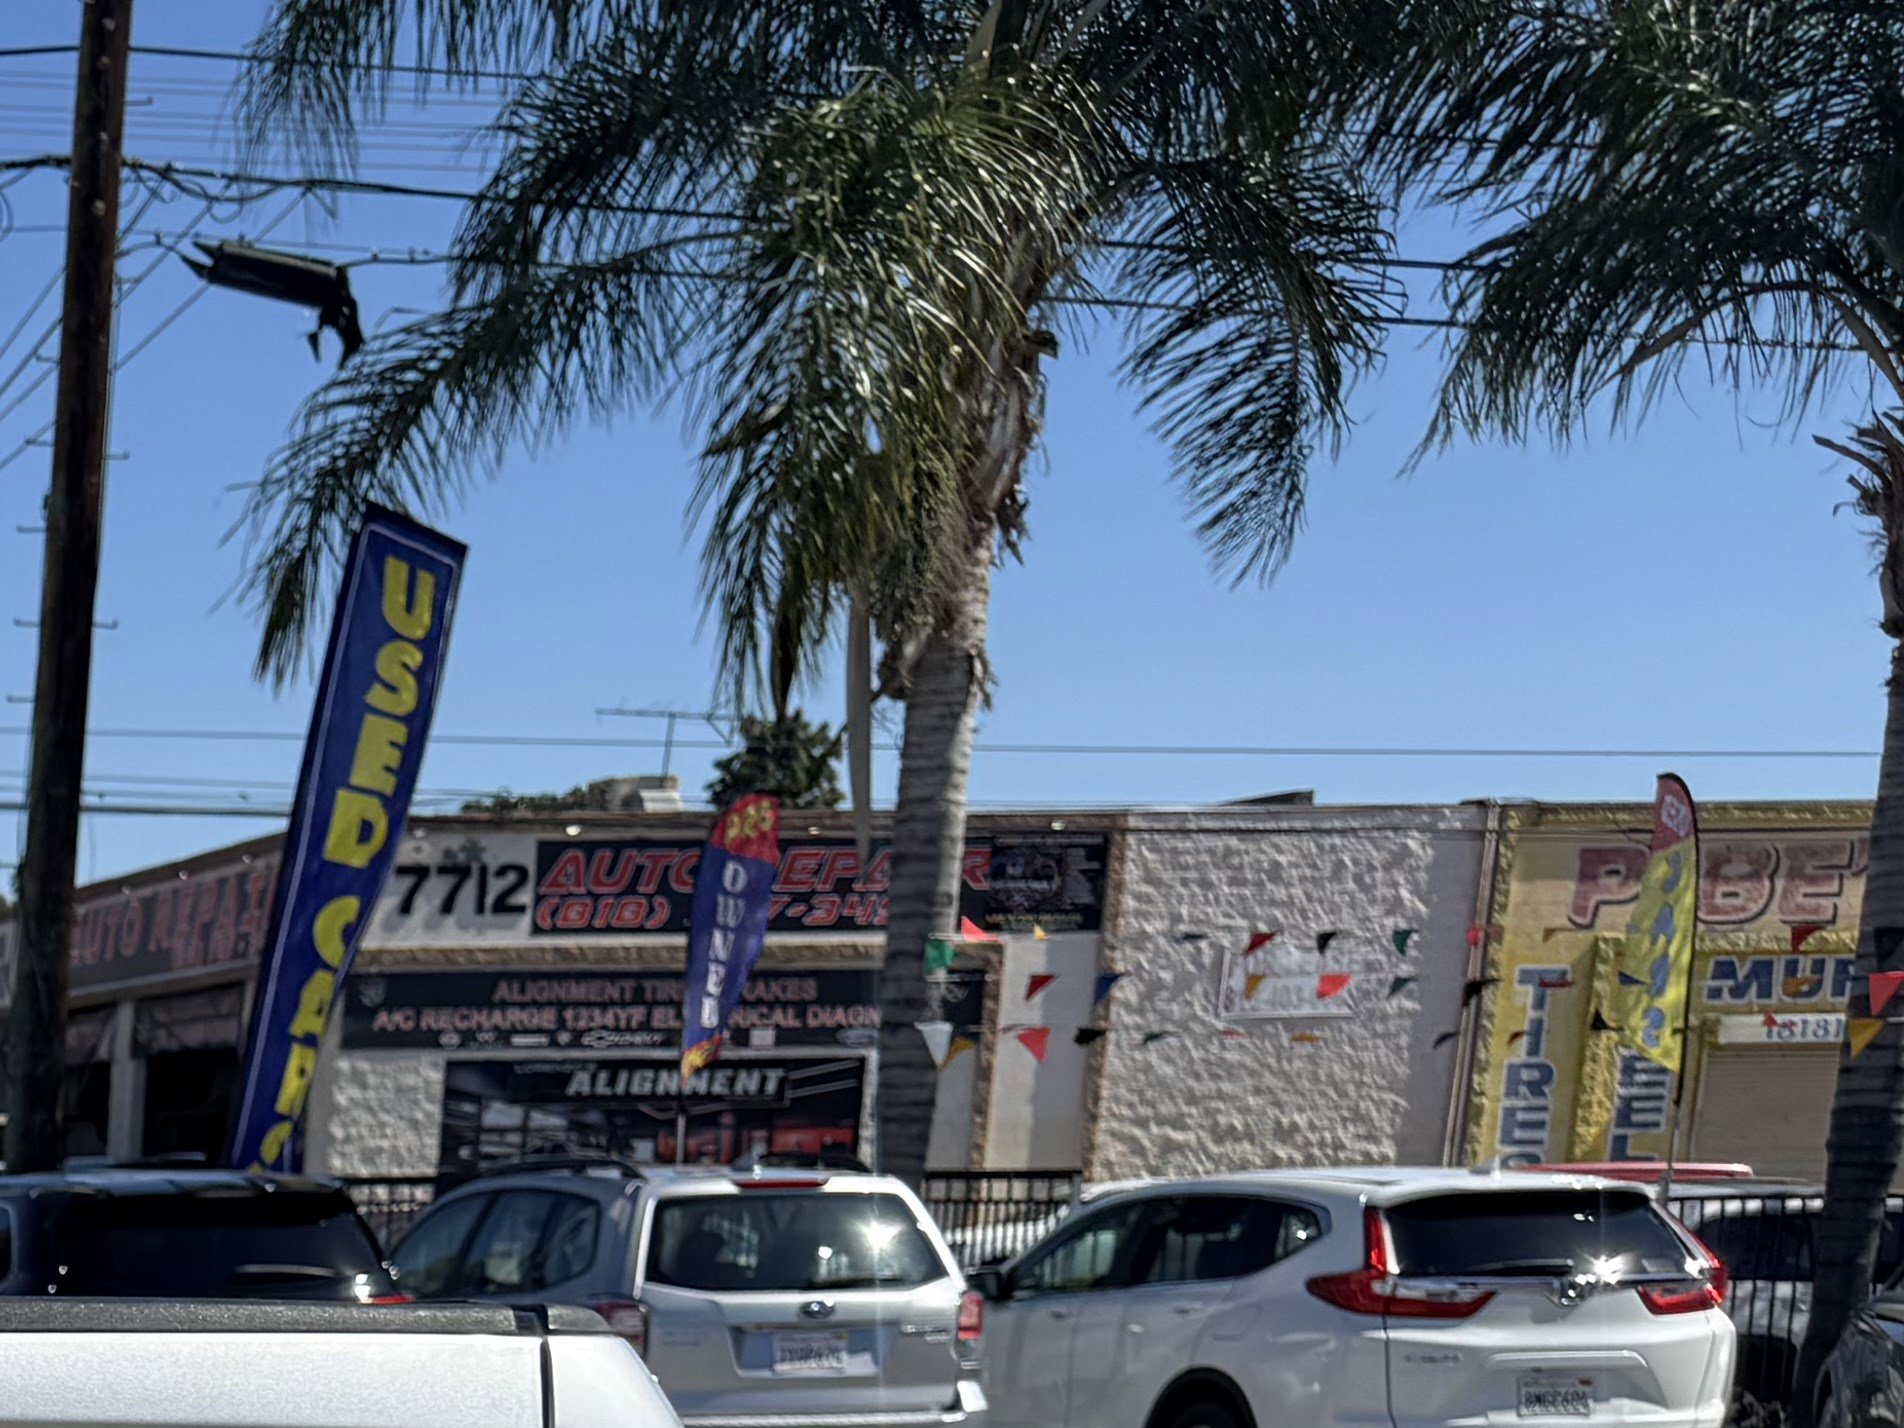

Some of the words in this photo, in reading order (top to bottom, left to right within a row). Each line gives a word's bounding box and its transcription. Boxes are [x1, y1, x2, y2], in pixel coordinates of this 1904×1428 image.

[323, 556, 435, 868] USED
[395, 863, 529, 915] 7712
[771, 844, 991, 893] EPAR
[492, 978, 637, 1003] ALIGNMENT
[419, 1005, 559, 1031] RECHARGE
[806, 1003, 883, 1029] DIAGN
[565, 1068, 786, 1096] ALIGNMENT
[1496, 963, 1571, 1163] TIRE
